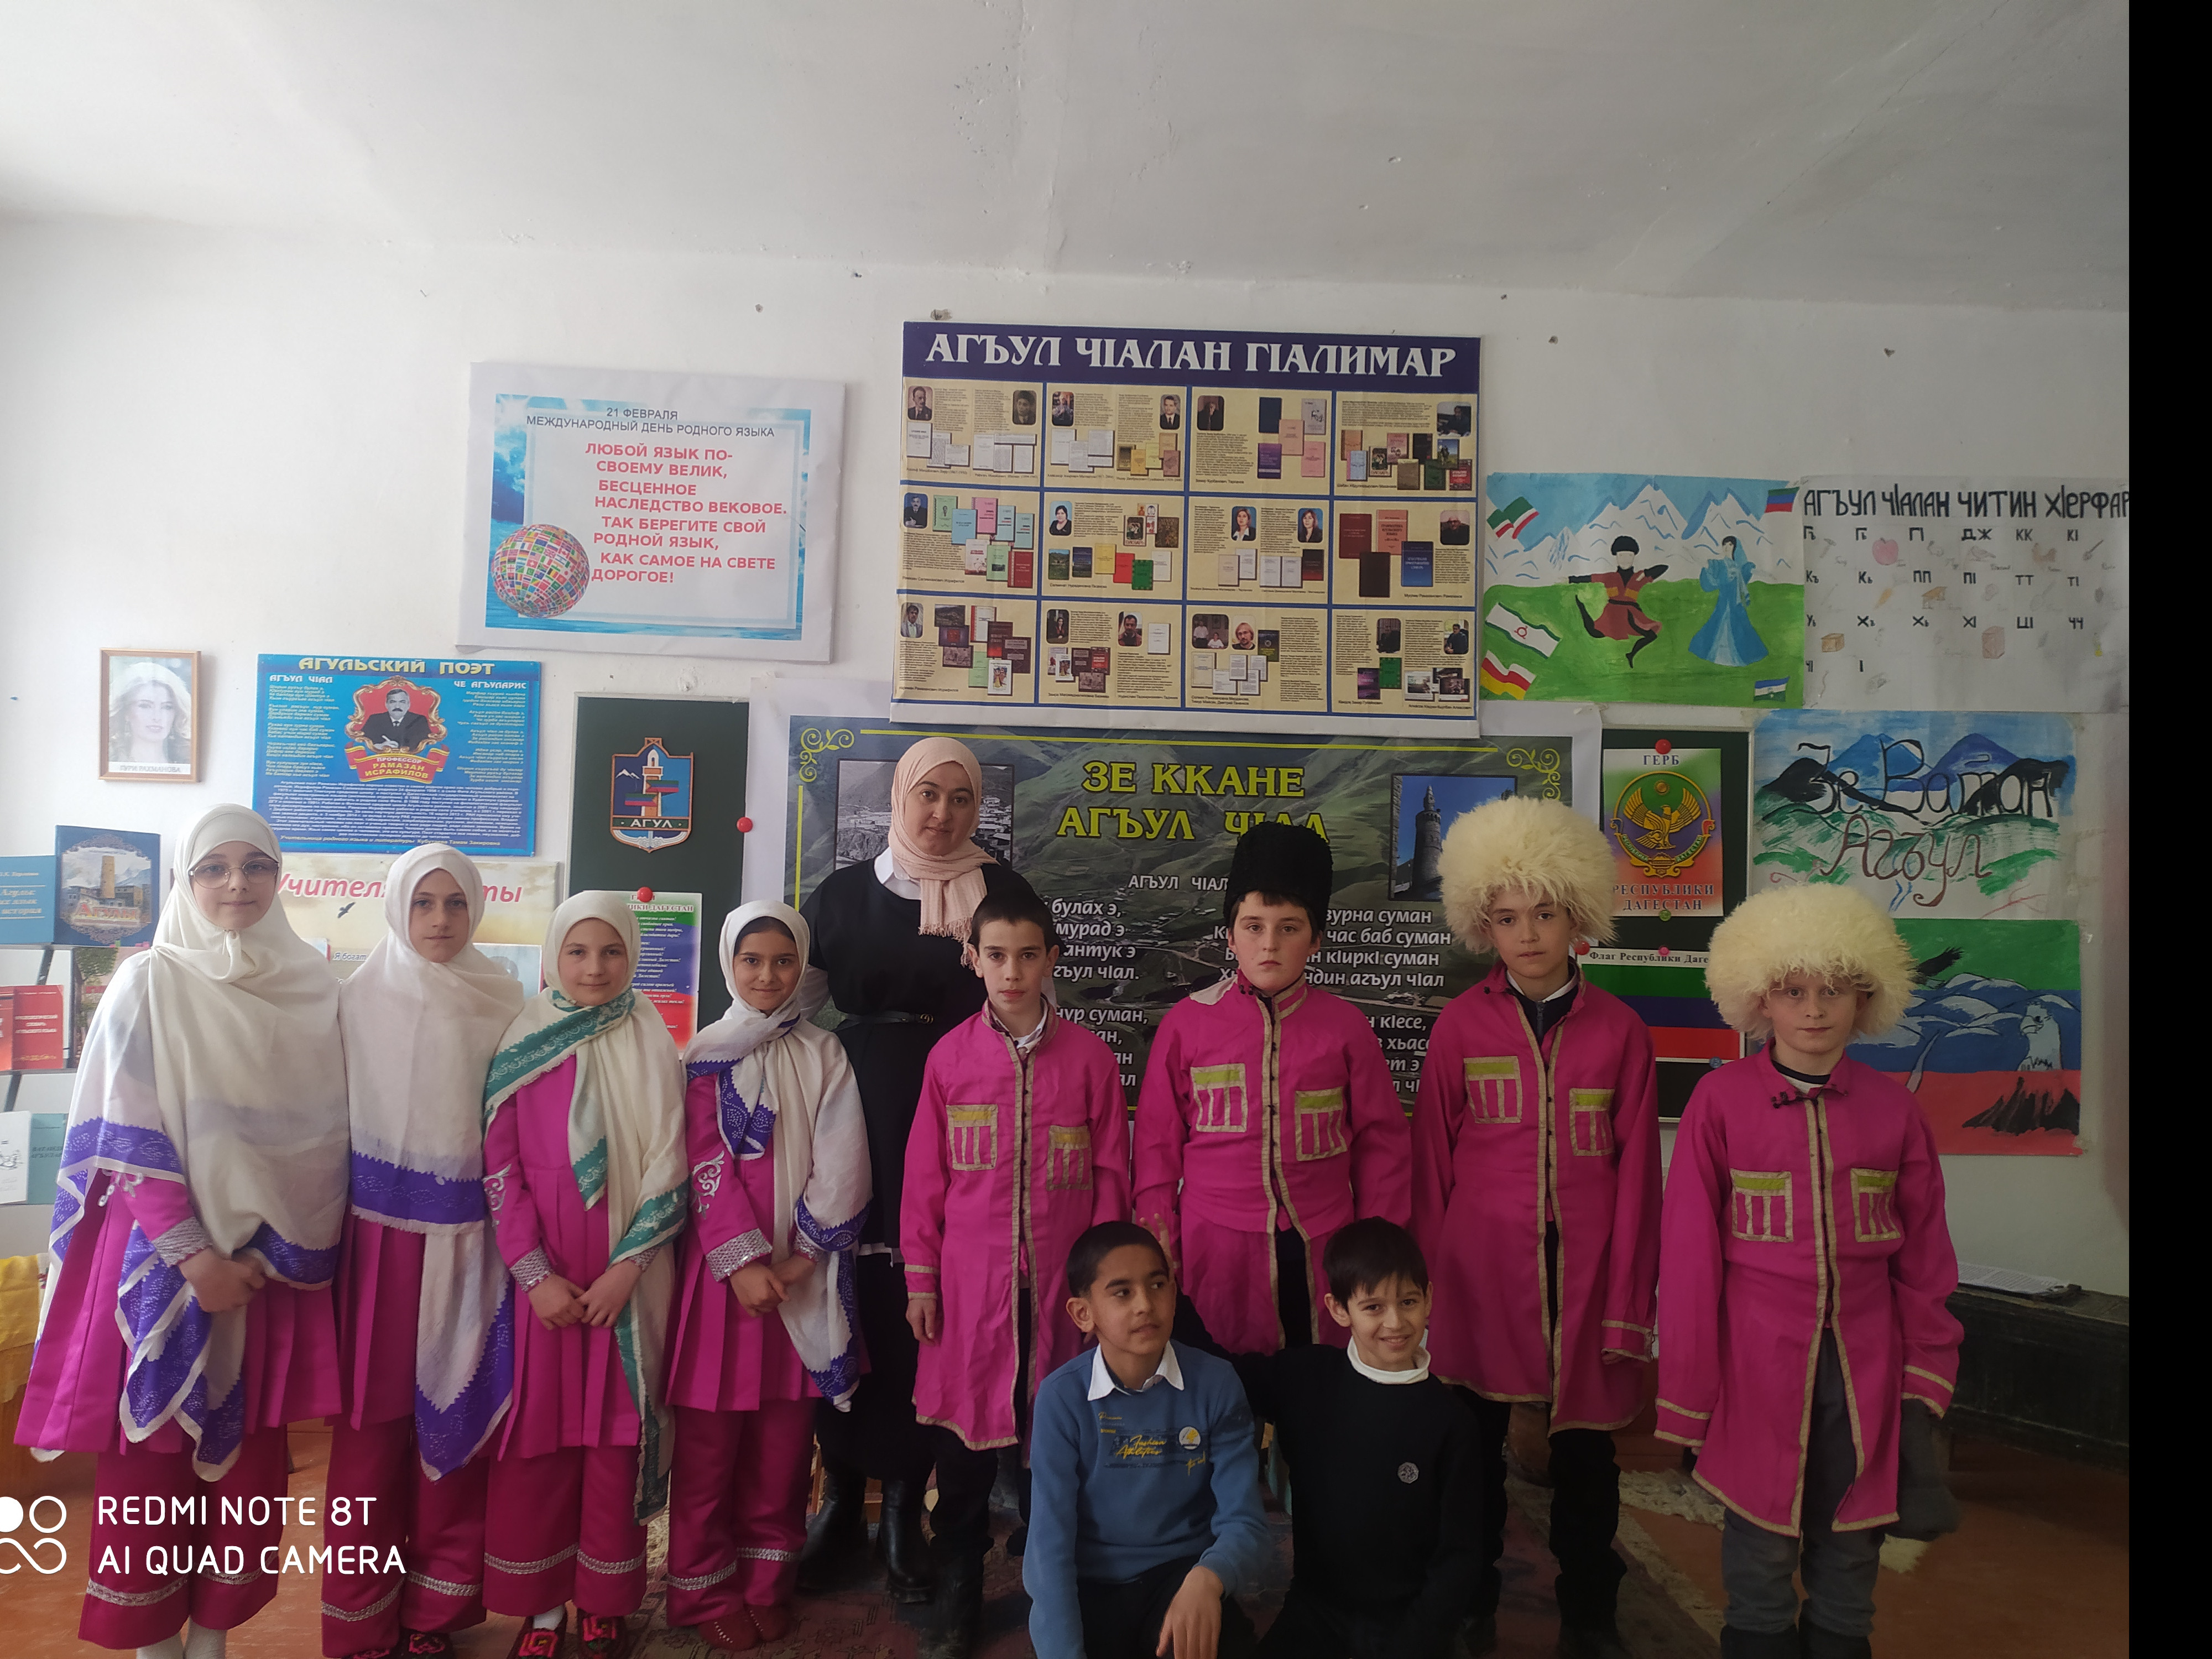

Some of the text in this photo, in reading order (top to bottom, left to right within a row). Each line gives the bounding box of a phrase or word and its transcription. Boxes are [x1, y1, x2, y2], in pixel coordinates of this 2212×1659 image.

[926, 333, 1061, 367] АГЪУЛ
[607, 408, 679, 421] 21 ФЕВРАЛЯ
[526, 415, 775, 438] МЕЖДУНАРОДНЫЙ ДЕНЬ РОДНОГО ЯЗЫКА
[585, 442, 733, 462] ЛЮБОЙ ЯЗЫК ПО-
[596, 460, 728, 479] СВОЕМУ ВЕЛИК,
[598, 479, 697, 497] БЕСЦЕННОЕ
[594, 496, 787, 515] НАСЛЕДСТВО ВЕКОВОЕ.
[1804, 489, 1876, 517] АГЪУЛ
[1958, 489, 2037, 518] ЧИТИН
[601, 516, 766, 534] ТАК БЕРЕГИТЕ СВОЙ
[593, 532, 719, 552] РОДНОЙ ЯЗЫК,
[1961, 528, 1992, 541] ДЖ
[2016, 529, 2033, 542] КК
[601, 552, 776, 570] КАК САМОЕ НА СВЕТЕ
[591, 570, 674, 584] ДОРОГОЕ!
[1913, 570, 1932, 583] ПП
[2015, 575, 2034, 586] ТТ
[299, 657, 495, 675] АГУЛЬСКИЙ ПОЭТ
[373, 763, 425, 771] РАМАЗАН
[1642, 755, 1680, 765] ГЕРБ
[364, 769, 429, 779] ИСРАФИЛОВ
[1082, 760, 1305, 797] ЗЕ ККАНЕ
[630, 818, 674, 828] АГУЛ
[1056, 807, 1195, 840] АГЪУЛ
[1128, 875, 1178, 890] АГЪУЛ
[1613, 884, 1714, 896] РЕСПУБЛИКИ
[1052, 898, 1121, 918] булах э,
[1623, 899, 1703, 911] ДАГЕСТАН
[1326, 909, 1432, 926] зурна суман
[1056, 921, 1125, 940] мурад э
[1327, 927, 1452, 948] час баб суман
[1126, 946, 1136, 958] э
[1384, 952, 1439, 969] суман
[1589, 951, 1616, 961] Флаг
[1620, 952, 1681, 963] Республики
[1350, 972, 1402, 990] агъул
[1088, 1009, 1149, 1025] суман,
